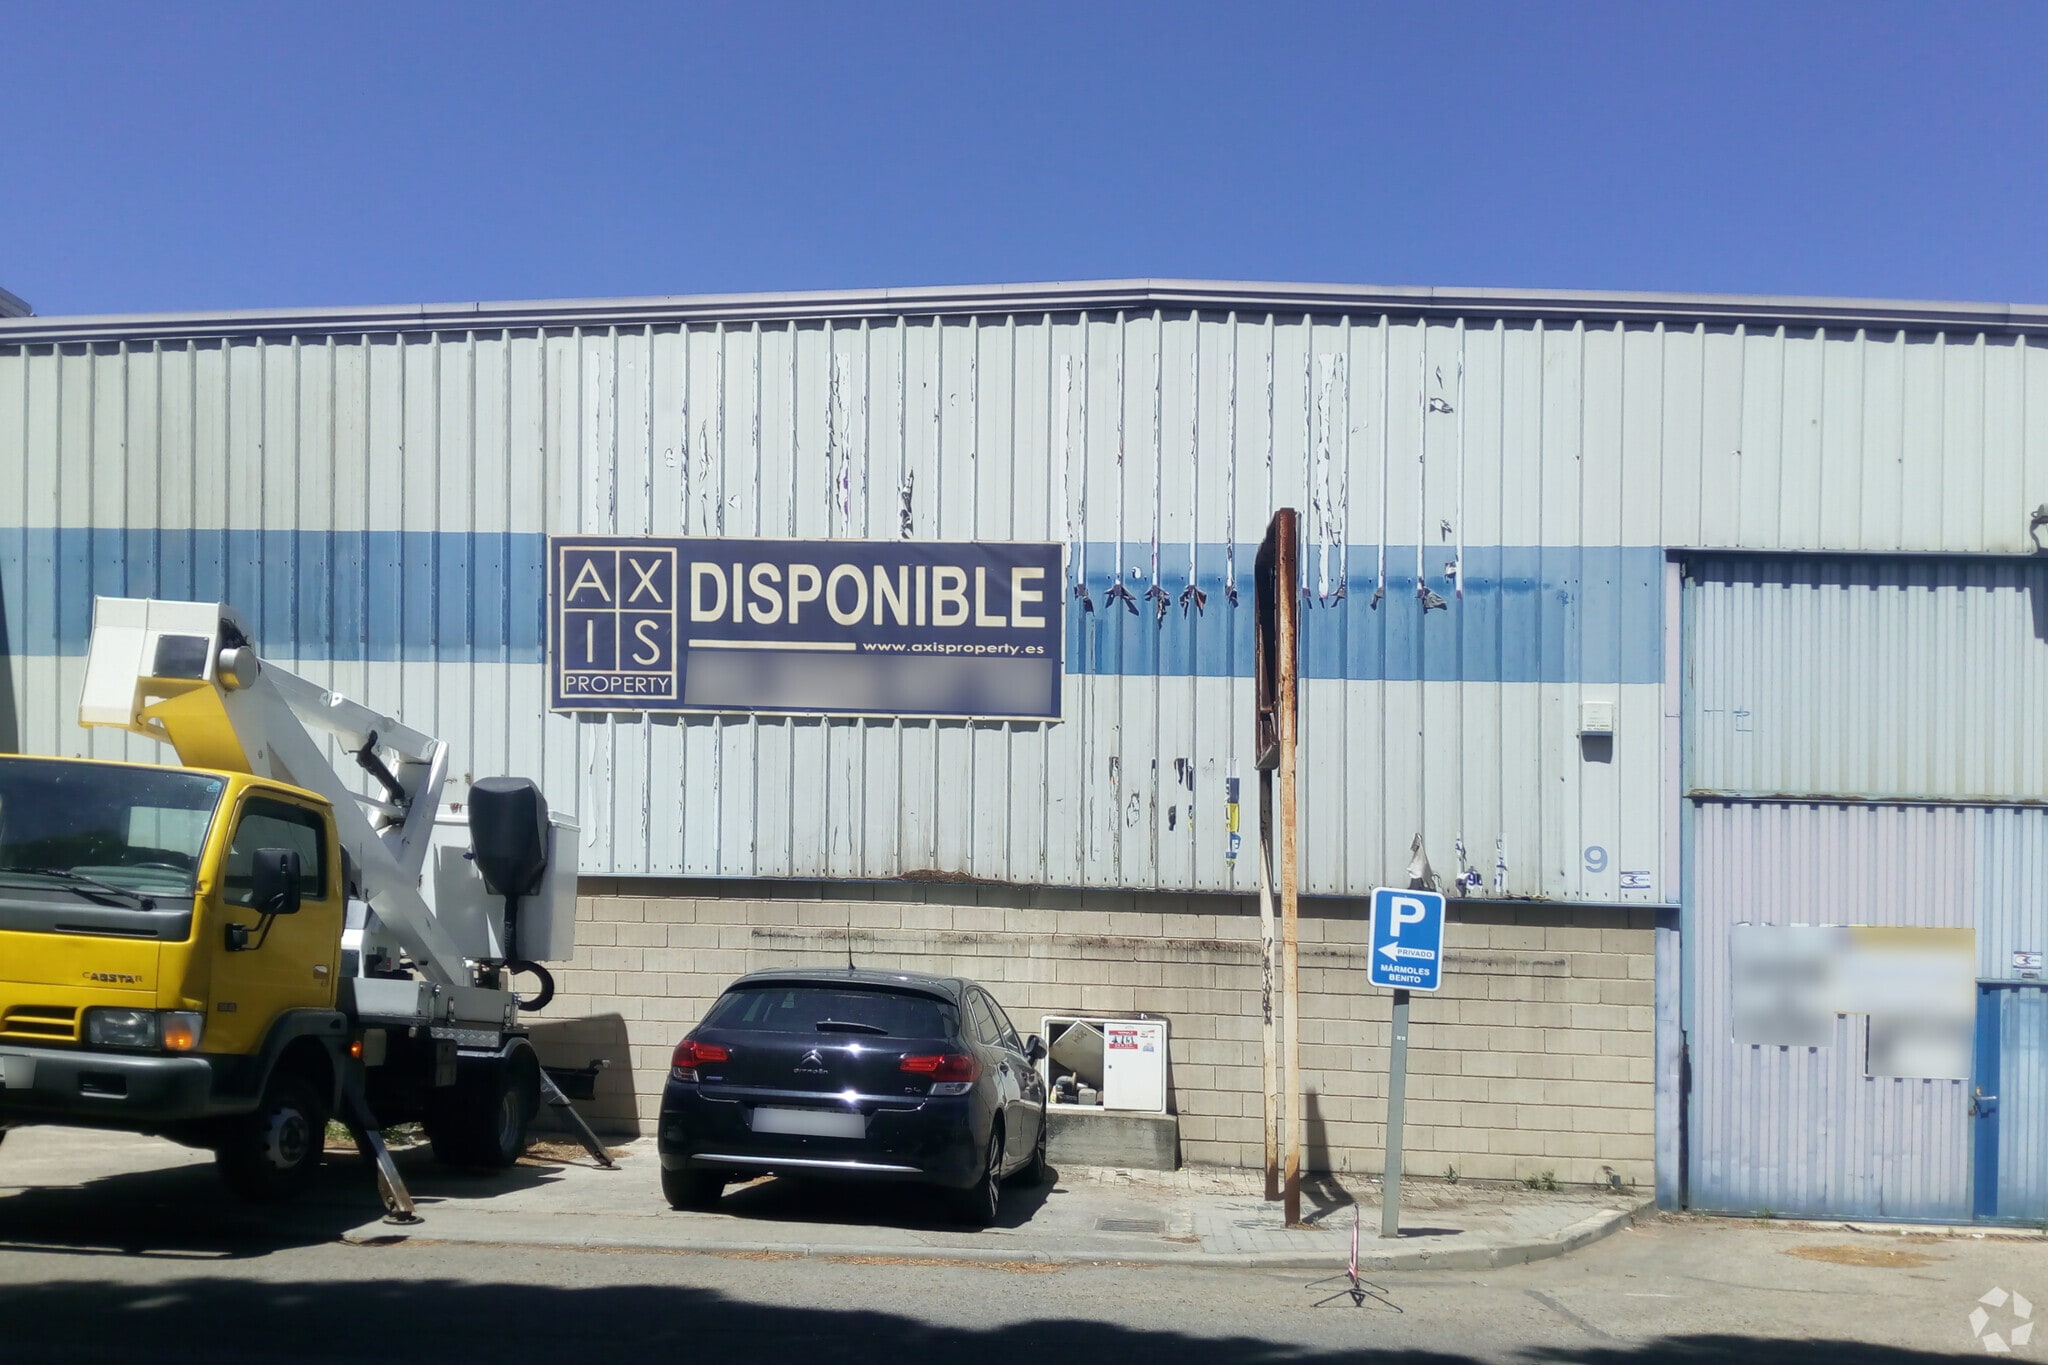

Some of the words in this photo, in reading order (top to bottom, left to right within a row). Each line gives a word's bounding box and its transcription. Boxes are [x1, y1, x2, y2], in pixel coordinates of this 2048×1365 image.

[690, 561, 1046, 628] DISPONIBLE
[863, 642, 1045, 655] www.axisproperty.es
[566, 675, 669, 693] PROPERTY
[1584, 846, 1608, 873] 9
[1390, 896, 1426, 937] P
[1397, 948, 1433, 958] PRIVADO
[1389, 973, 1421, 984] BENITO
